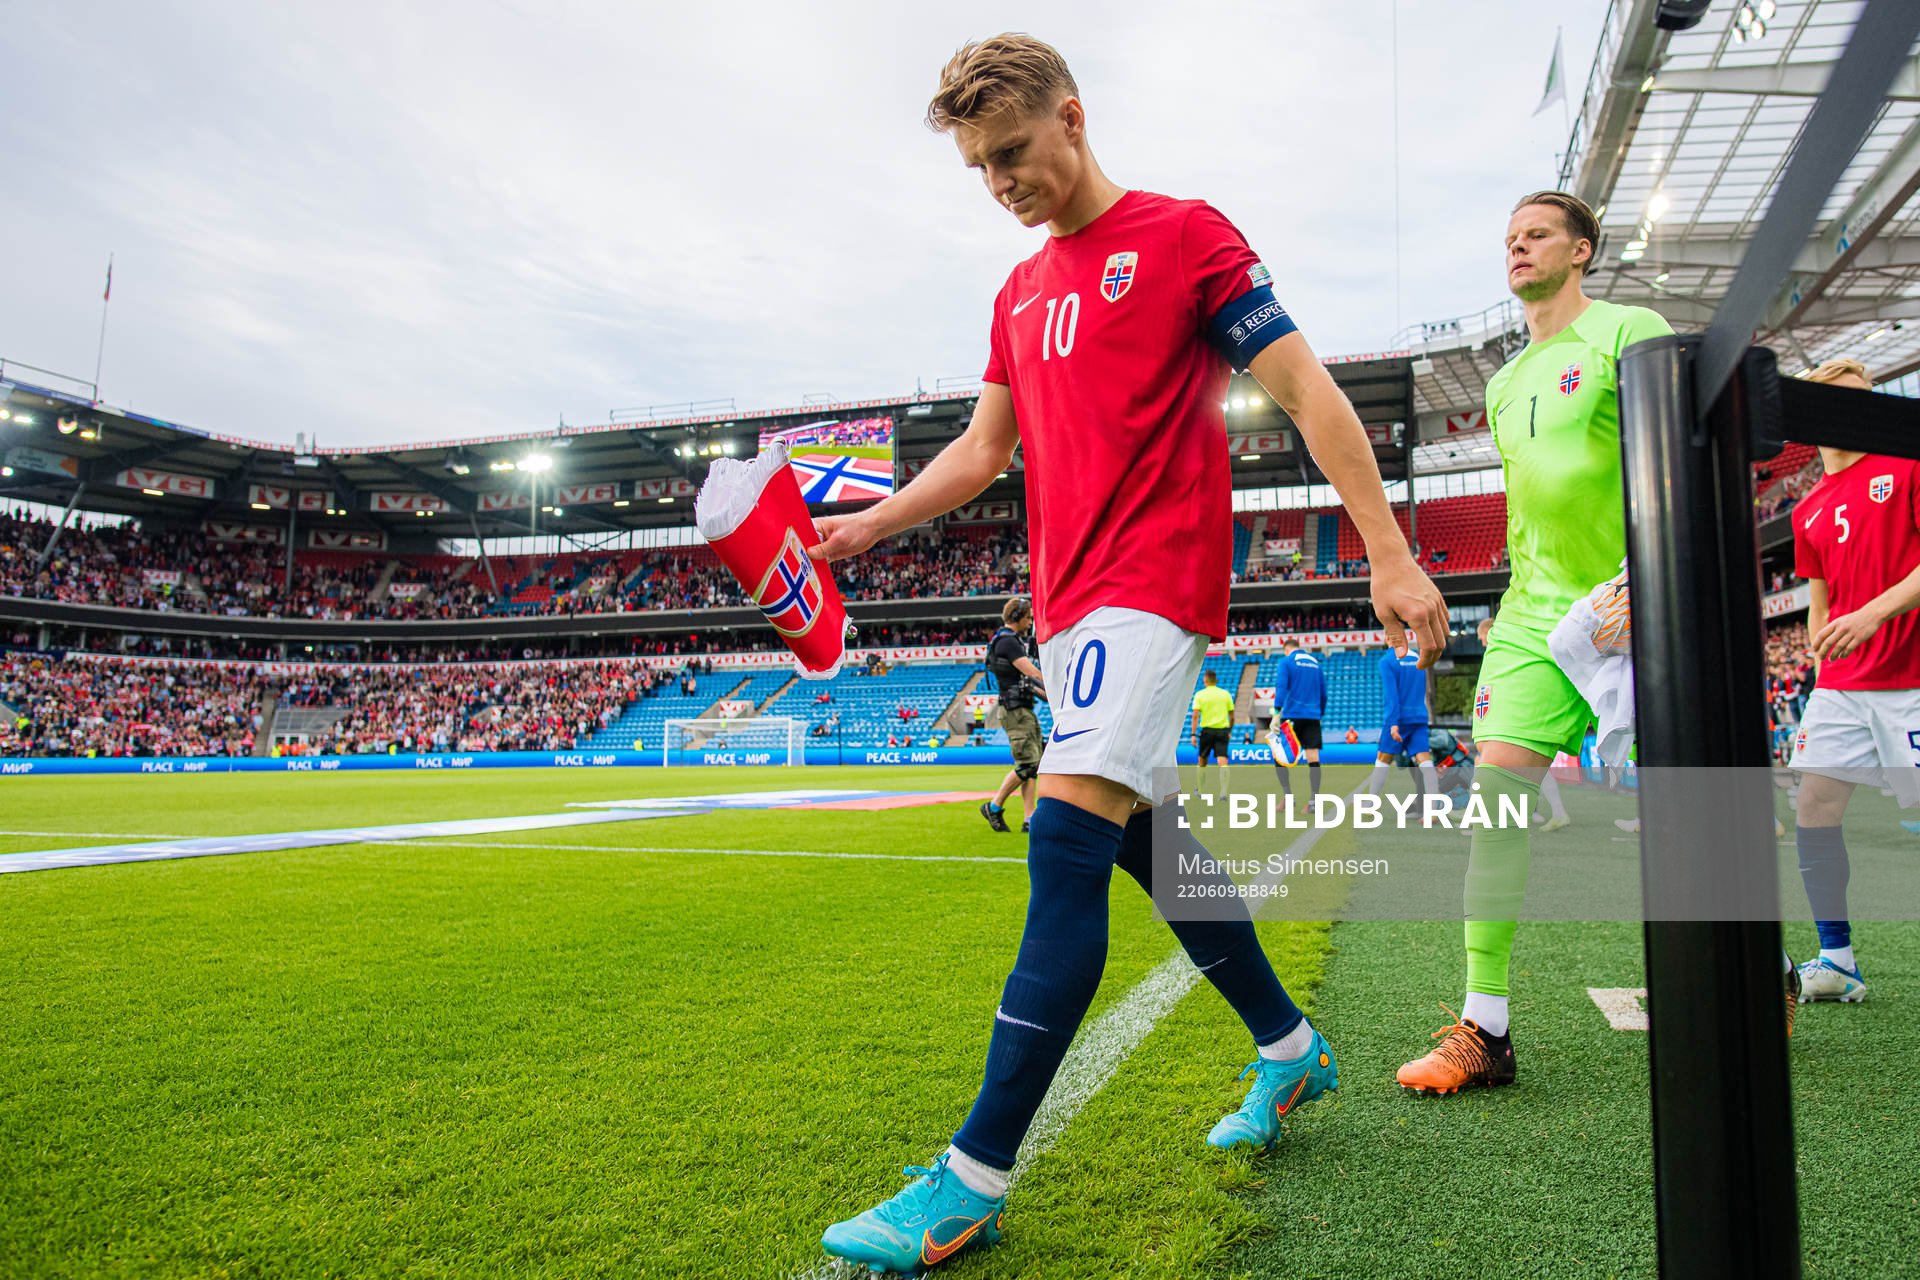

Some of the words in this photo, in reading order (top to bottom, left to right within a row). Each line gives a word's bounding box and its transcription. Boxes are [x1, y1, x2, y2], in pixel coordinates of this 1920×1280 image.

[1043, 292, 1080, 361] 10
[1530, 395, 1538, 438] 1
[128, 468, 205, 496] VG
[559, 484, 615, 503] VG
[378, 493, 443, 510] VG
[949, 502, 1012, 521] VG
[1834, 503, 1850, 544] 5
[1233, 636, 1271, 647] VG
[1326, 633, 1365, 644] VG
[893, 649, 927, 659] VG
[933, 647, 967, 658] VG
[555, 755, 583, 766] PEACE
[704, 753, 736, 764] PEACE
[866, 752, 900, 763] PEACE
[1231, 749, 1271, 761] PEACE
